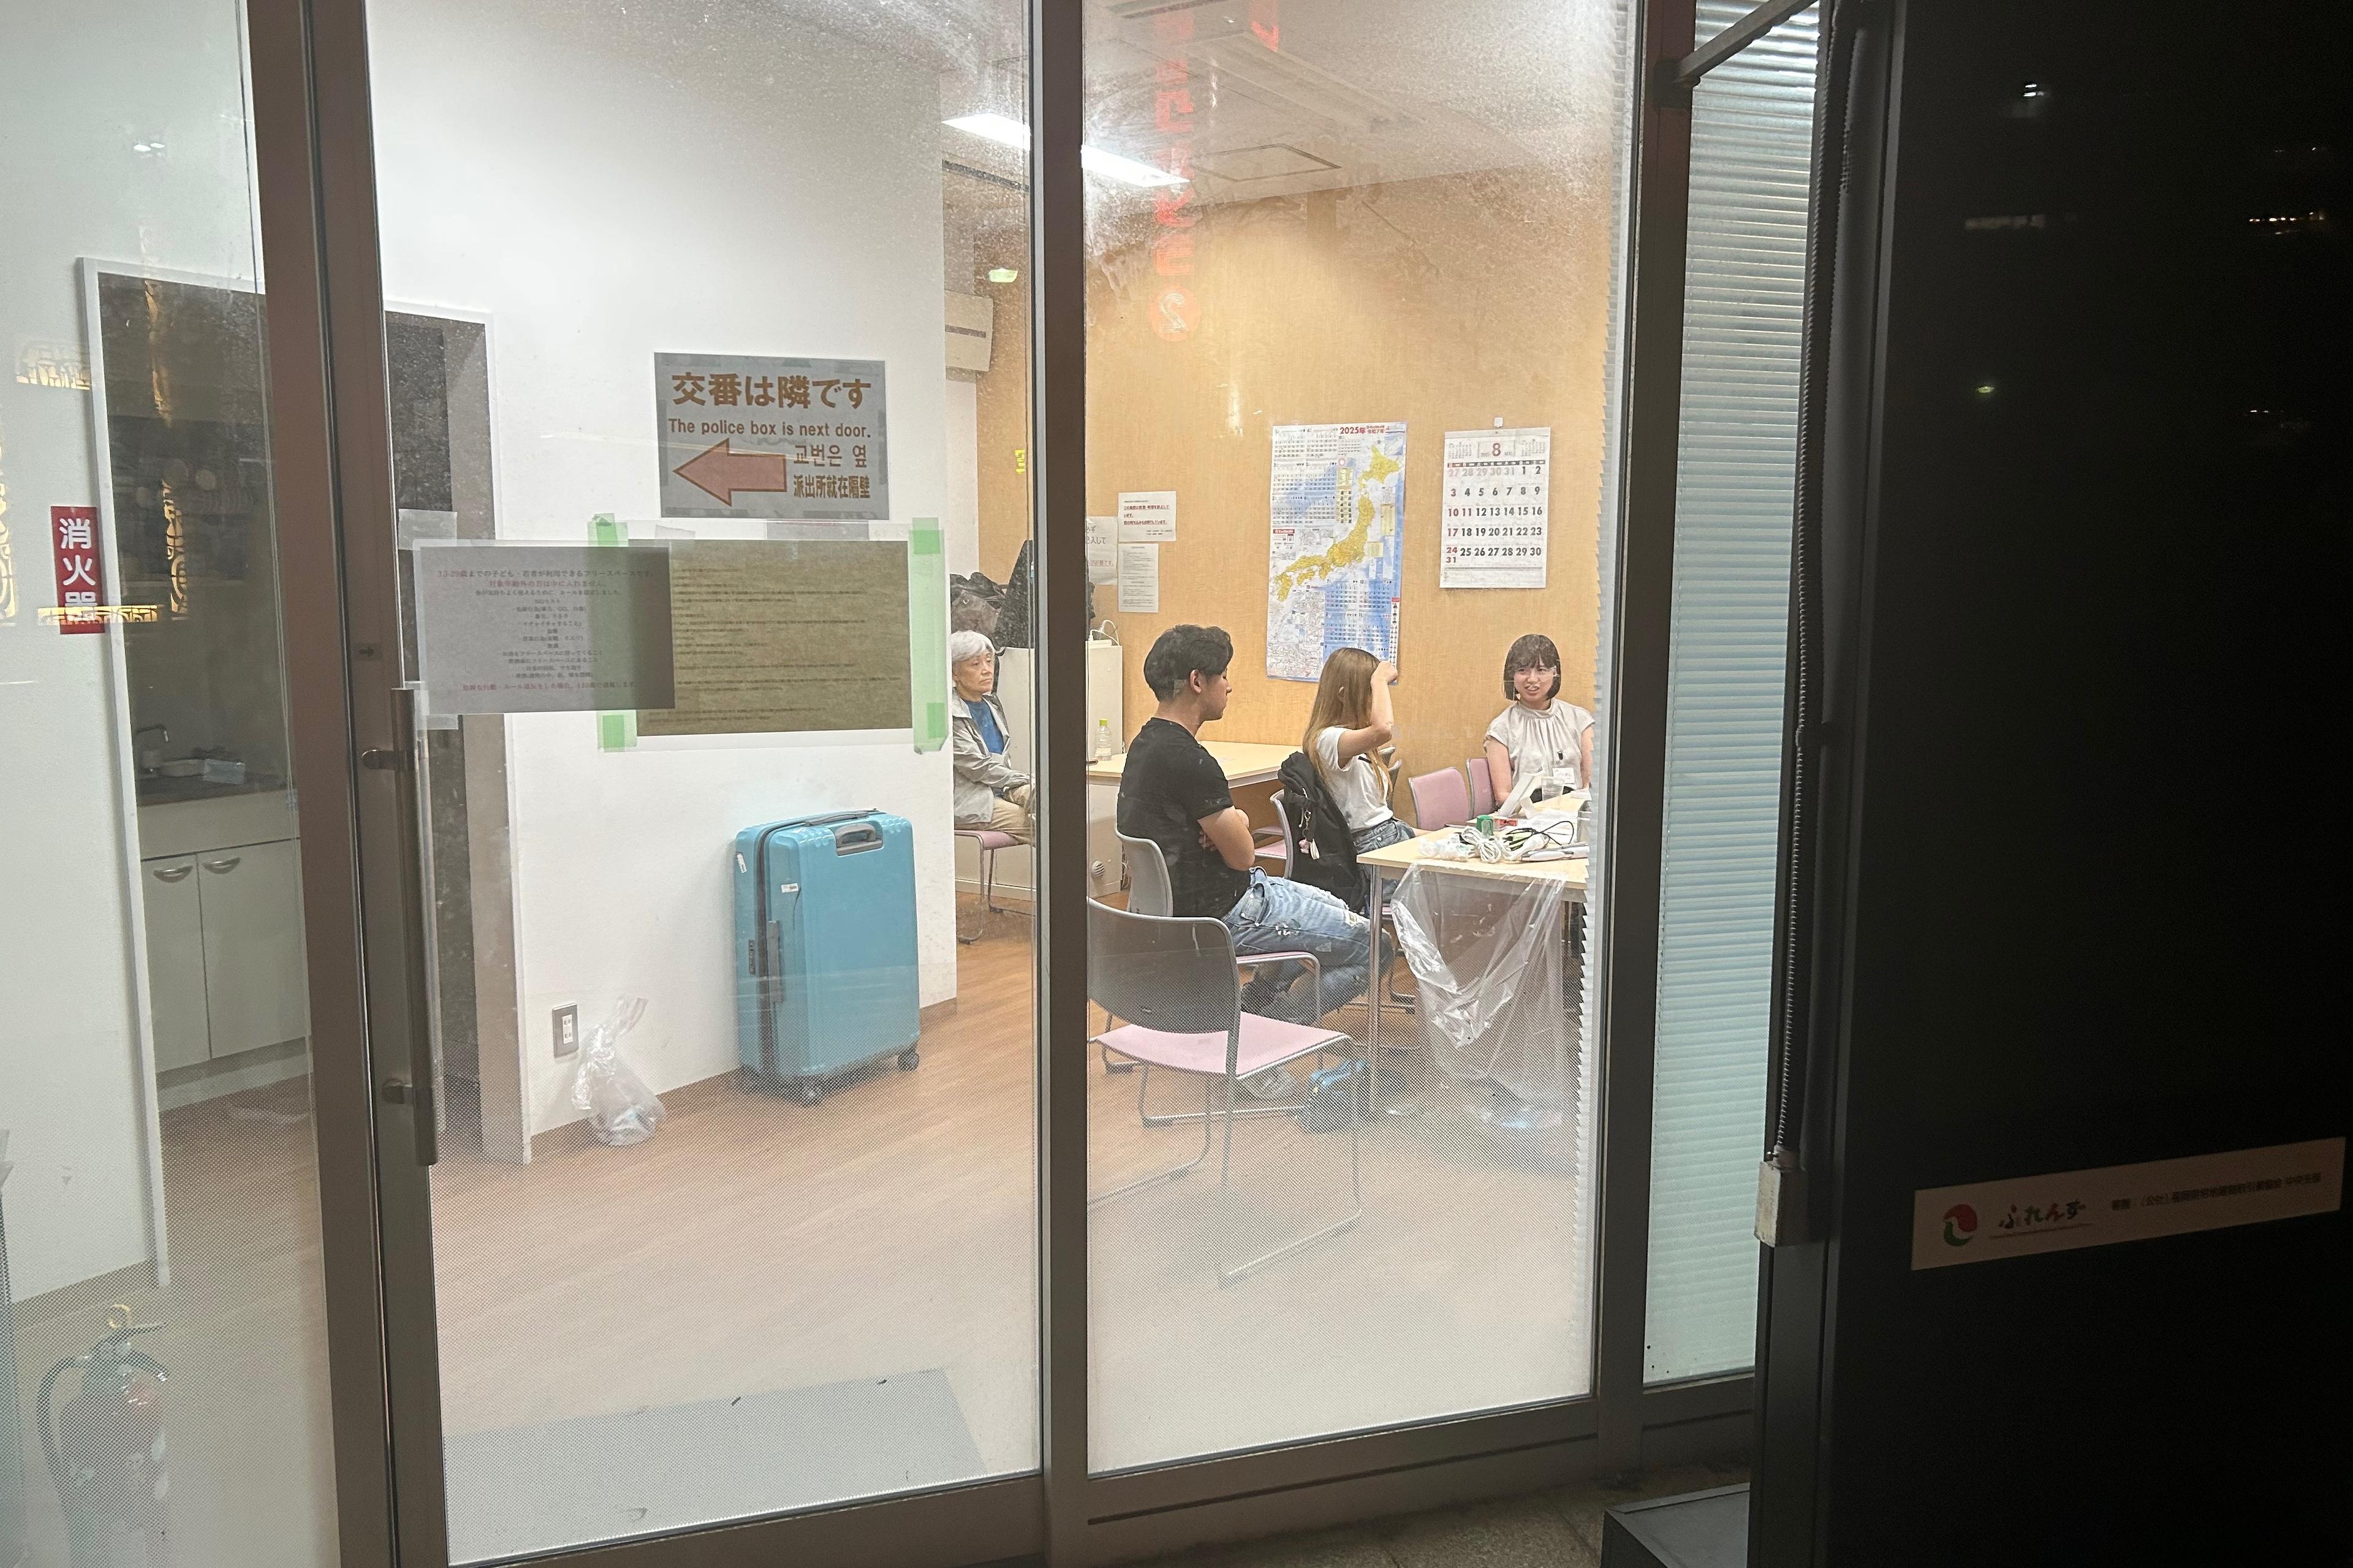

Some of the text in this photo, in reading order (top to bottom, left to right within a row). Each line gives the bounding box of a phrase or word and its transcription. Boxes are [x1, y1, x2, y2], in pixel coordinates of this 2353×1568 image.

[672, 372, 871, 409] 交番は隣です
[668, 419, 871, 438] The police box is next door.
[1493, 442, 1501, 456] 8
[794, 444, 867, 468] 교번은 옆
[1448, 466, 1541, 477] 27 28 29 30 31 1 2
[1450, 487, 1540, 497] 3 4 5 6 7 8 9
[1448, 507, 1542, 517] 10 11 12 13 14 15 16
[1447, 527, 1542, 537] 17 18 19 20 21 22 23
[1460, 548, 1471, 556] 25
[1474, 548, 1485, 556] 26
[1488, 548, 1499, 556] 27
[1502, 547, 1514, 556] 28
[1515, 547, 1528, 556] 29
[1530, 547, 1542, 556] 30
[59, 518, 98, 621] 消火器
